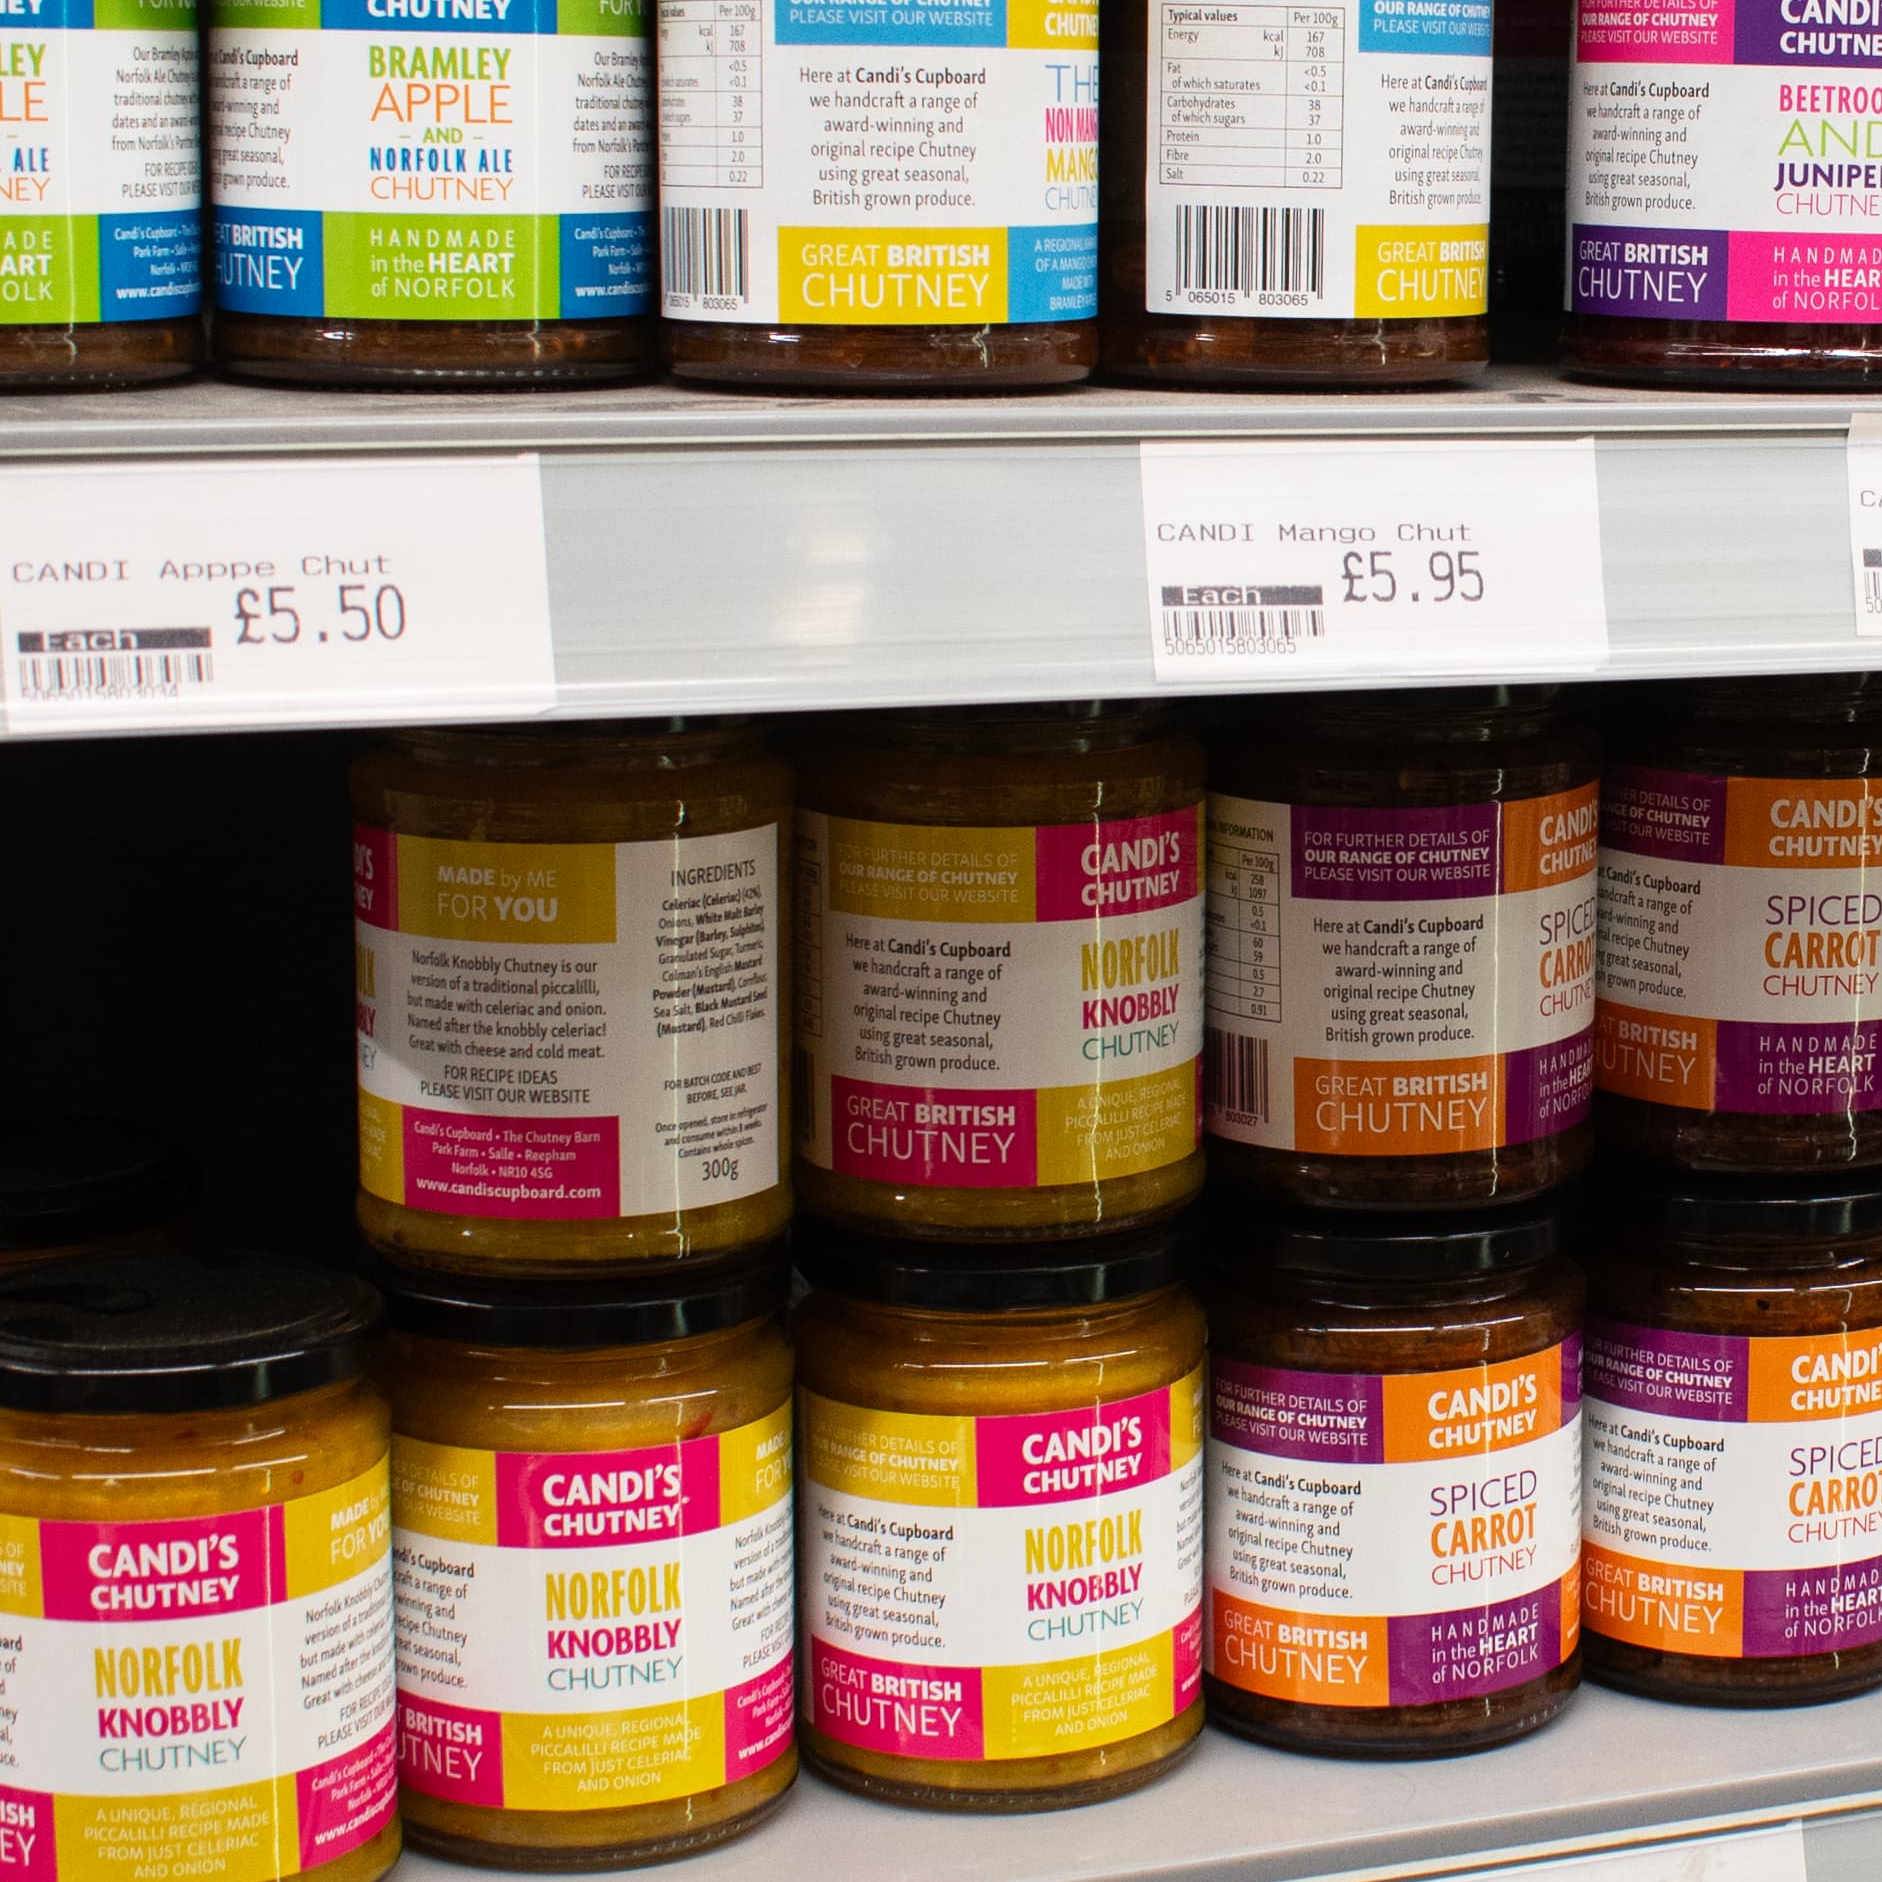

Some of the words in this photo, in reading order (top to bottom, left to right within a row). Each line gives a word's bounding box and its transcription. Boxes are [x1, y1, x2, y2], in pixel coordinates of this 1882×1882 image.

[370, 45, 512, 80] BRAMLEY
[800, 67, 831, 84] Here
[834, 68, 852, 84] at
[856, 67, 912, 84] Candi's
[915, 67, 986, 86] Cupboard
[371, 83, 513, 124] APPLE
[423, 127, 463, 144] AND
[1167, 130, 1199, 143] Protein
[370, 147, 466, 172] NORFOLK
[479, 150, 513, 172] ALE
[371, 175, 514, 201] CHUTNEY
[371, 228, 515, 249] HANDMADE
[372, 254, 387, 272] in
[393, 254, 424, 272] the
[429, 252, 515, 273] HEART
[802, 244, 880, 266] GREAT
[888, 245, 989, 266] BRITISH
[372, 277, 386, 298] of
[394, 276, 515, 298] NORFOLK
[802, 274, 988, 308] CHUTNEY
[1188, 291, 1236, 305] 065015
[1259, 292, 1308, 306] 803065
[1157, 524, 1254, 542] CANDI
[1279, 524, 1376, 544] Mango
[1397, 523, 1473, 541] Chut
[13, 561, 129, 582] CANDI
[160, 560, 275, 581] Apppe
[301, 555, 391, 575] Chut
[1341, 551, 1484, 603] £5.95
[234, 584, 406, 645] £5.50
[437, 866, 495, 888] MADE
[500, 870, 519, 893] by
[525, 869, 557, 890] ME
[437, 894, 487, 920] FOR
[493, 897, 559, 922] YOU
[88, 1535, 240, 1580] CANDI'S
[90, 1575, 240, 1611] CHUTNEY
[94, 1638, 243, 1699] NORFOLK
[99, 1697, 245, 1738] KNOBBLY
[99, 1736, 247, 1773] CHUTNEY
